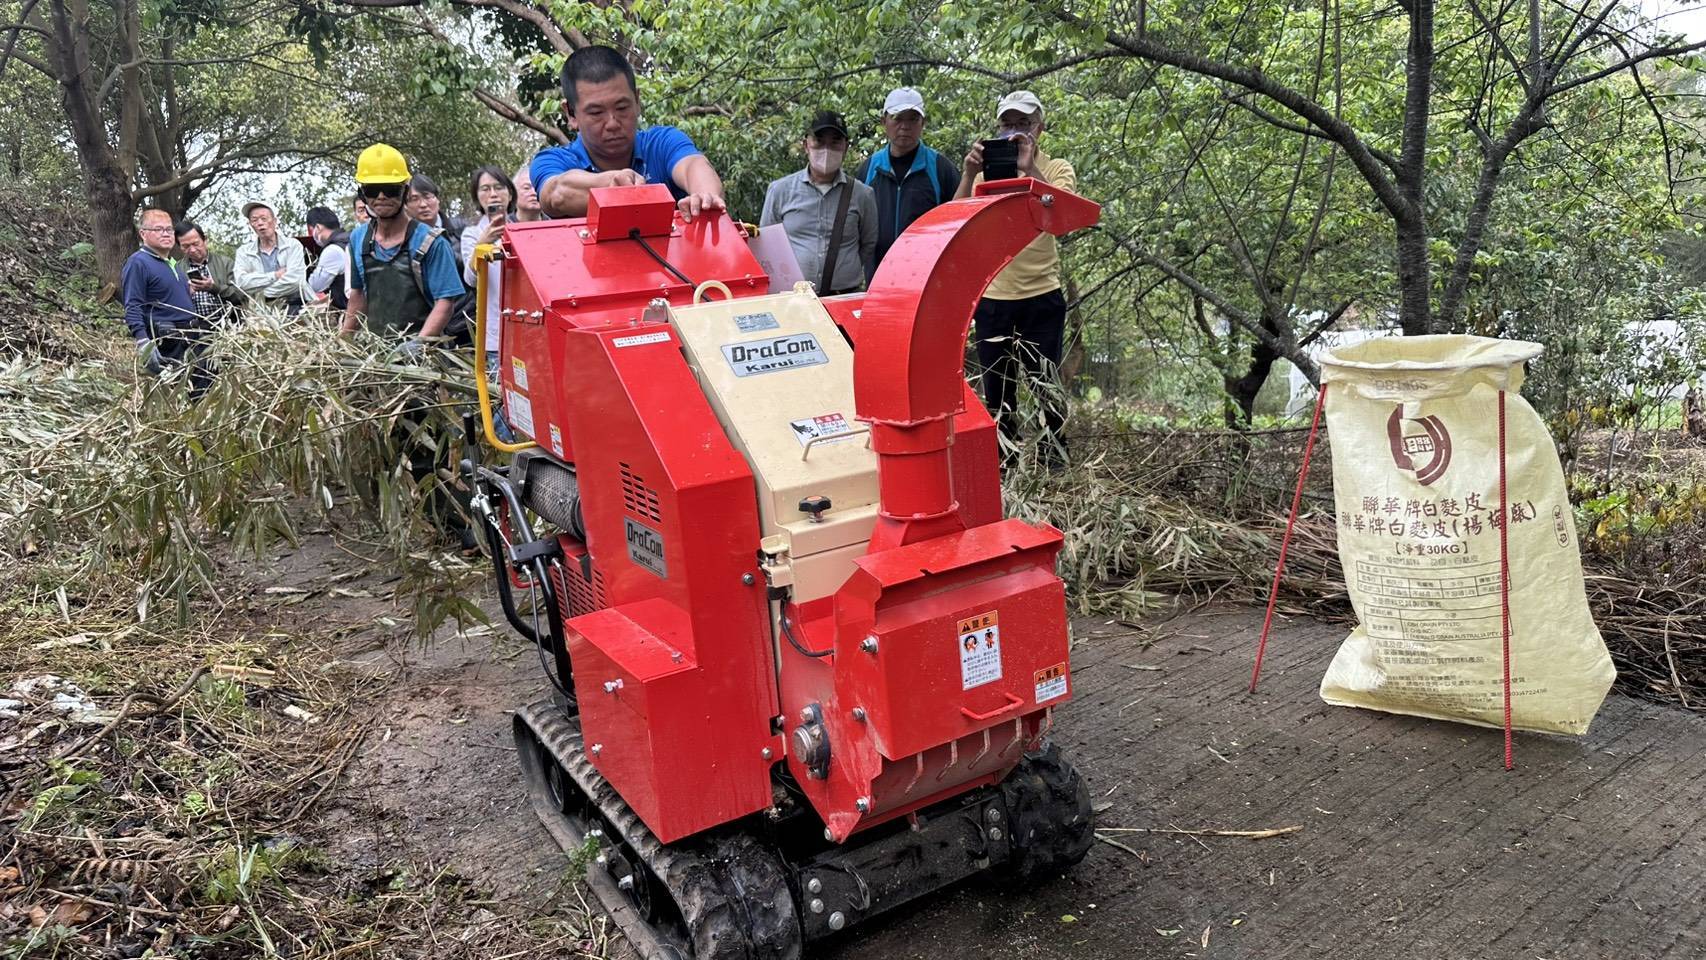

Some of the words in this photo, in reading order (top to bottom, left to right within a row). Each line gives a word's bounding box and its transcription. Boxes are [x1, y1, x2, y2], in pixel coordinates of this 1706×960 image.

[732, 339, 816, 362] DraCom
[746, 359, 795, 372] Karui
[627, 522, 663, 558] DraCom
